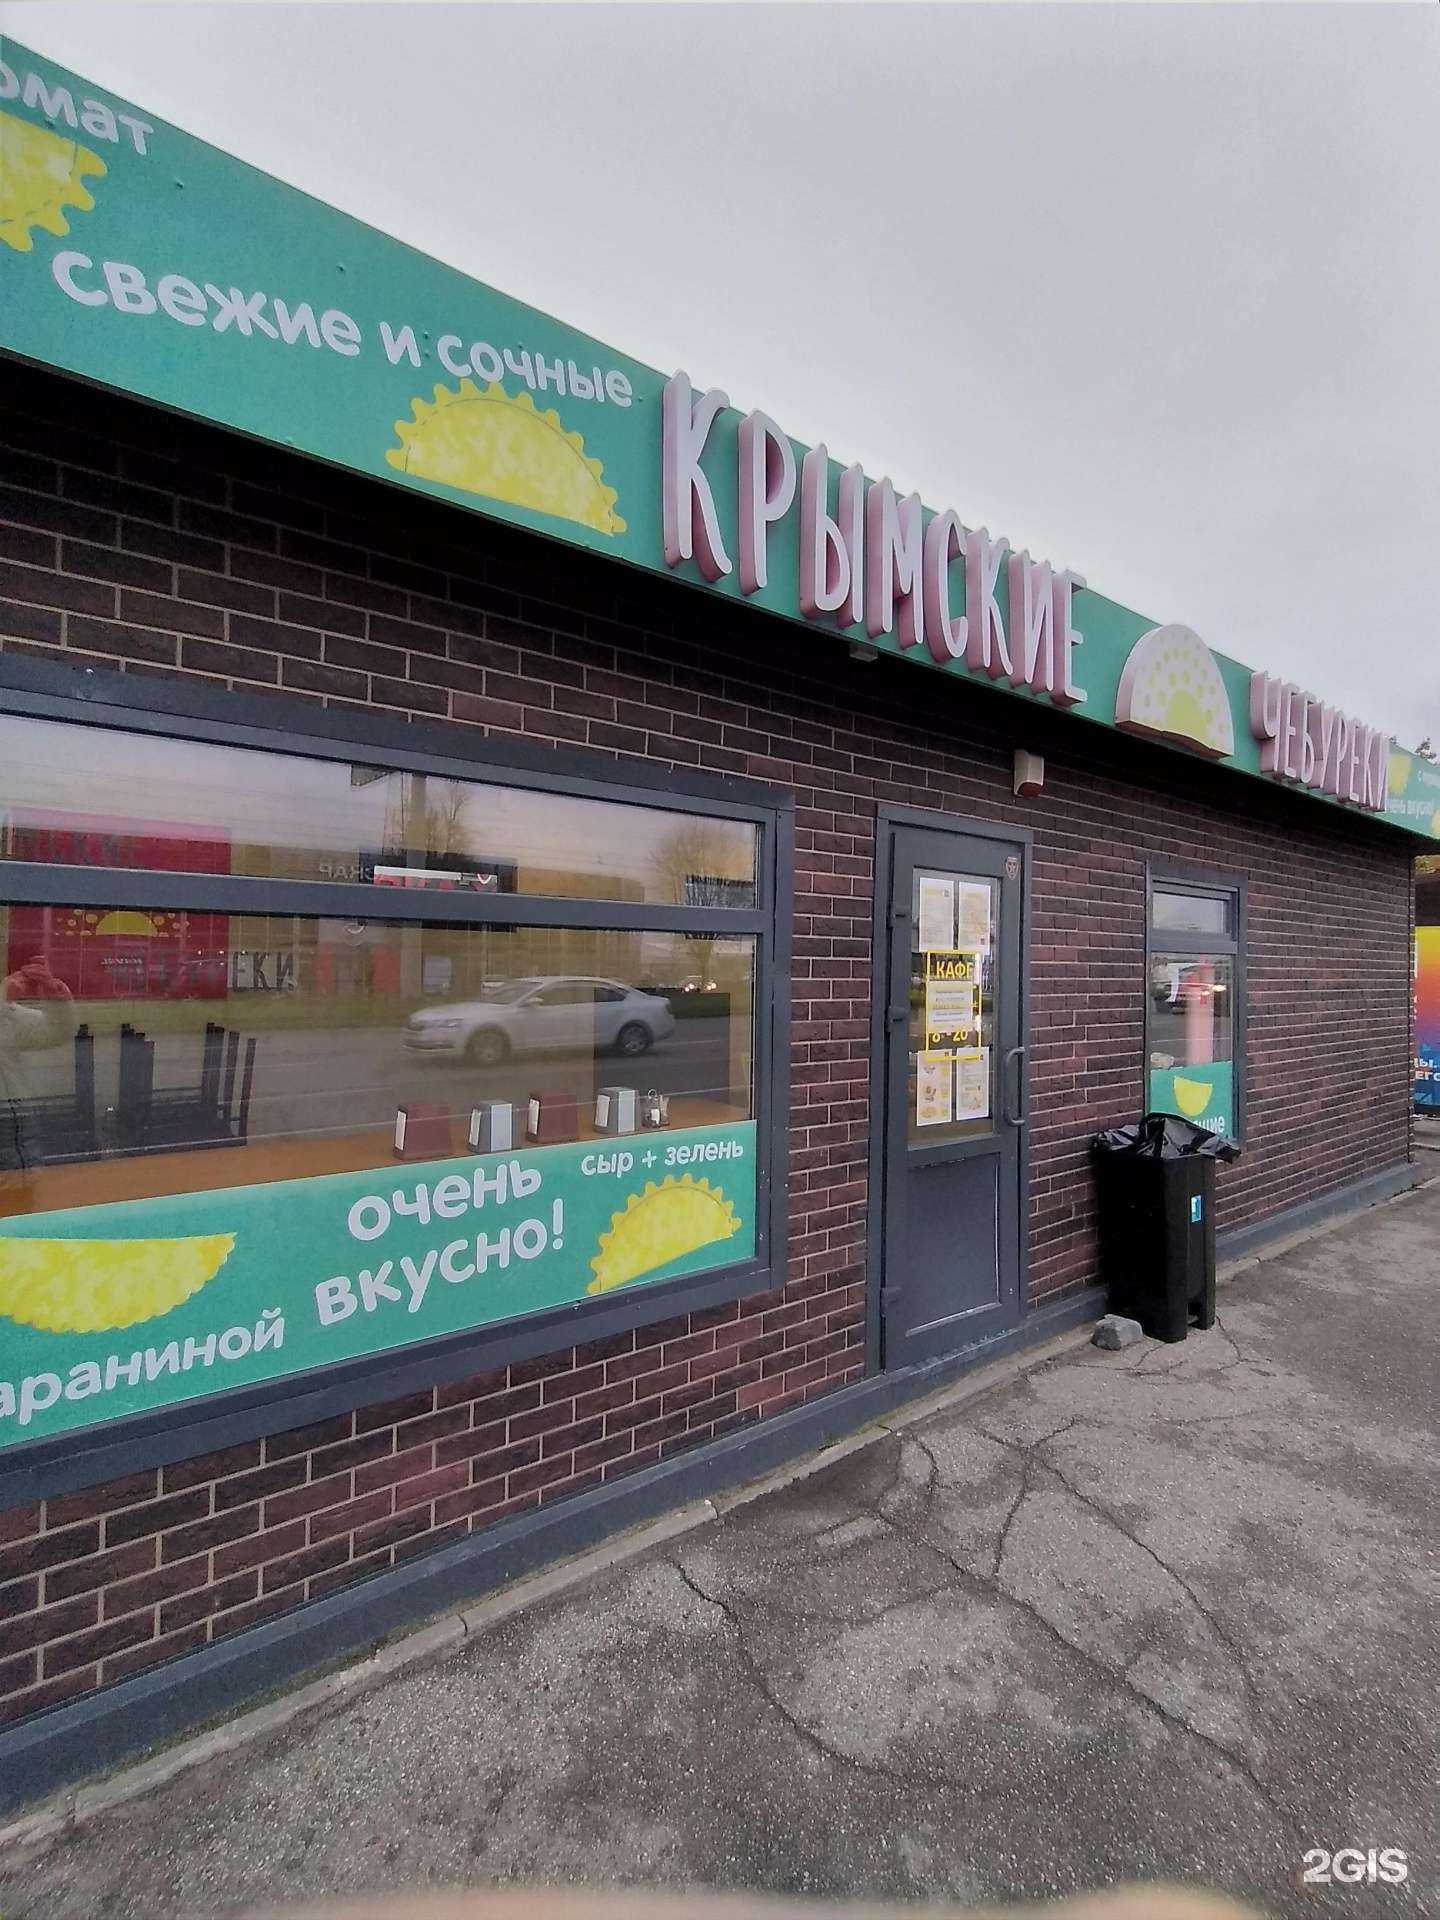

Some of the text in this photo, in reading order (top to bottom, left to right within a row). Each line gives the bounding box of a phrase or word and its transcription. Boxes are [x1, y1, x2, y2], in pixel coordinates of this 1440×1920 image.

[52, 251, 633, 408] свежие и сочные
[662, 369, 1088, 707] КРЫМСКИЕ
[1250, 671, 1389, 812] ЧЕБУРЕКИ
[936, 961, 973, 979] КАФЕ
[347, 1158, 543, 1241] очень
[581, 1152, 634, 1178] сыр
[664, 1140, 744, 1166] зелень
[314, 1198, 566, 1328] вкусно!
